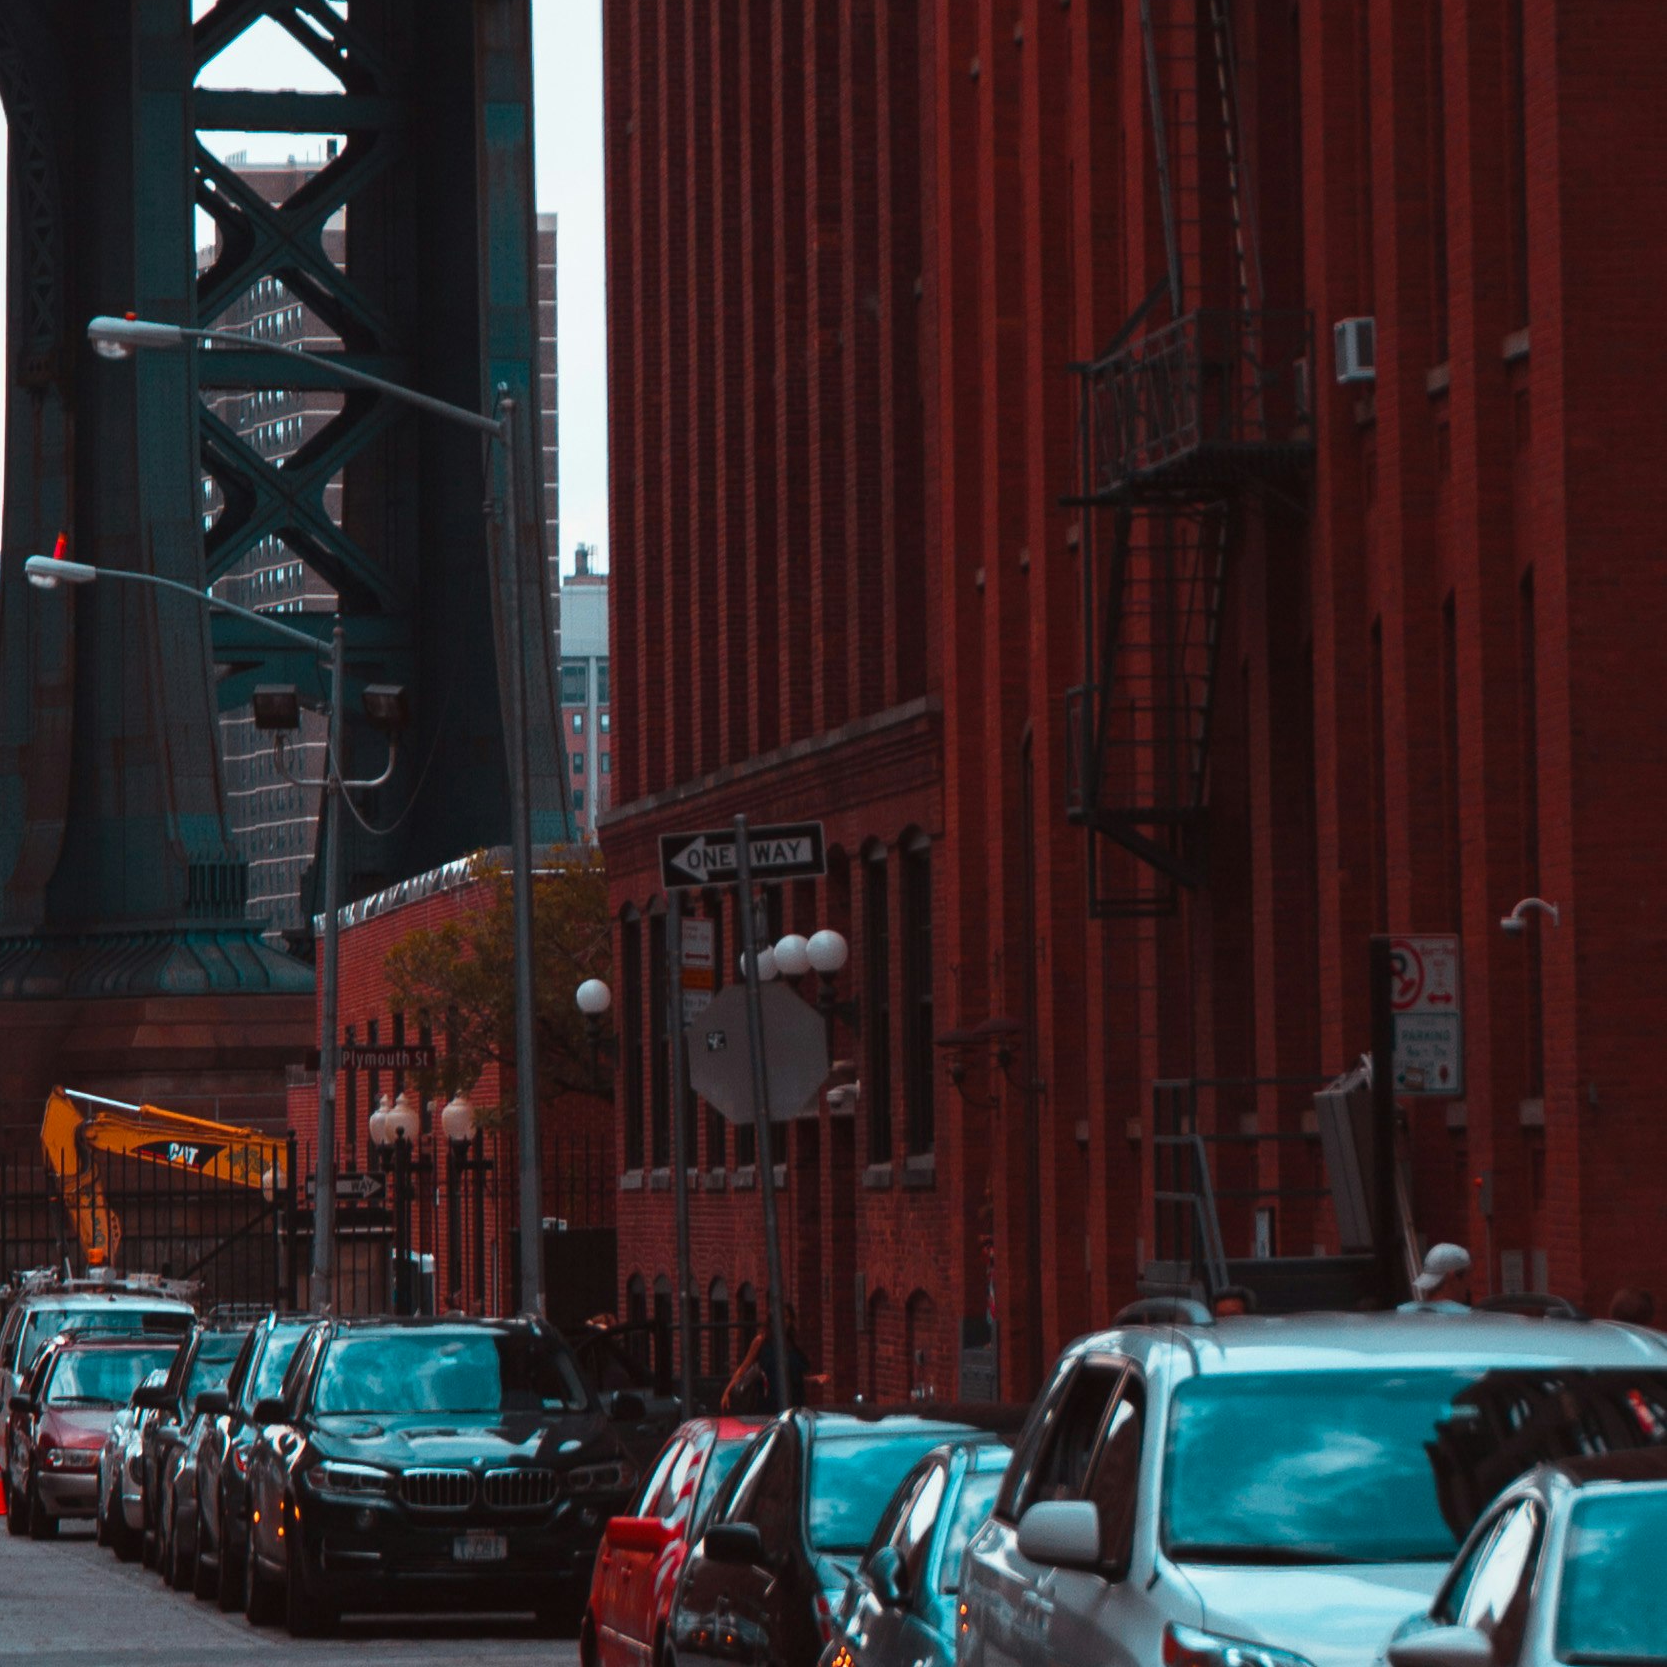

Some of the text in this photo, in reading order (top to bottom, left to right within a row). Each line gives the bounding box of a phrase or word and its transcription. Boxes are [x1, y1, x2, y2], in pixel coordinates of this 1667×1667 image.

[686, 839, 801, 869] ONE WAY
[342, 1050, 428, 1068] Plymouth St
[167, 1142, 199, 1166] CAT
[350, 1179, 375, 1192] WAY
